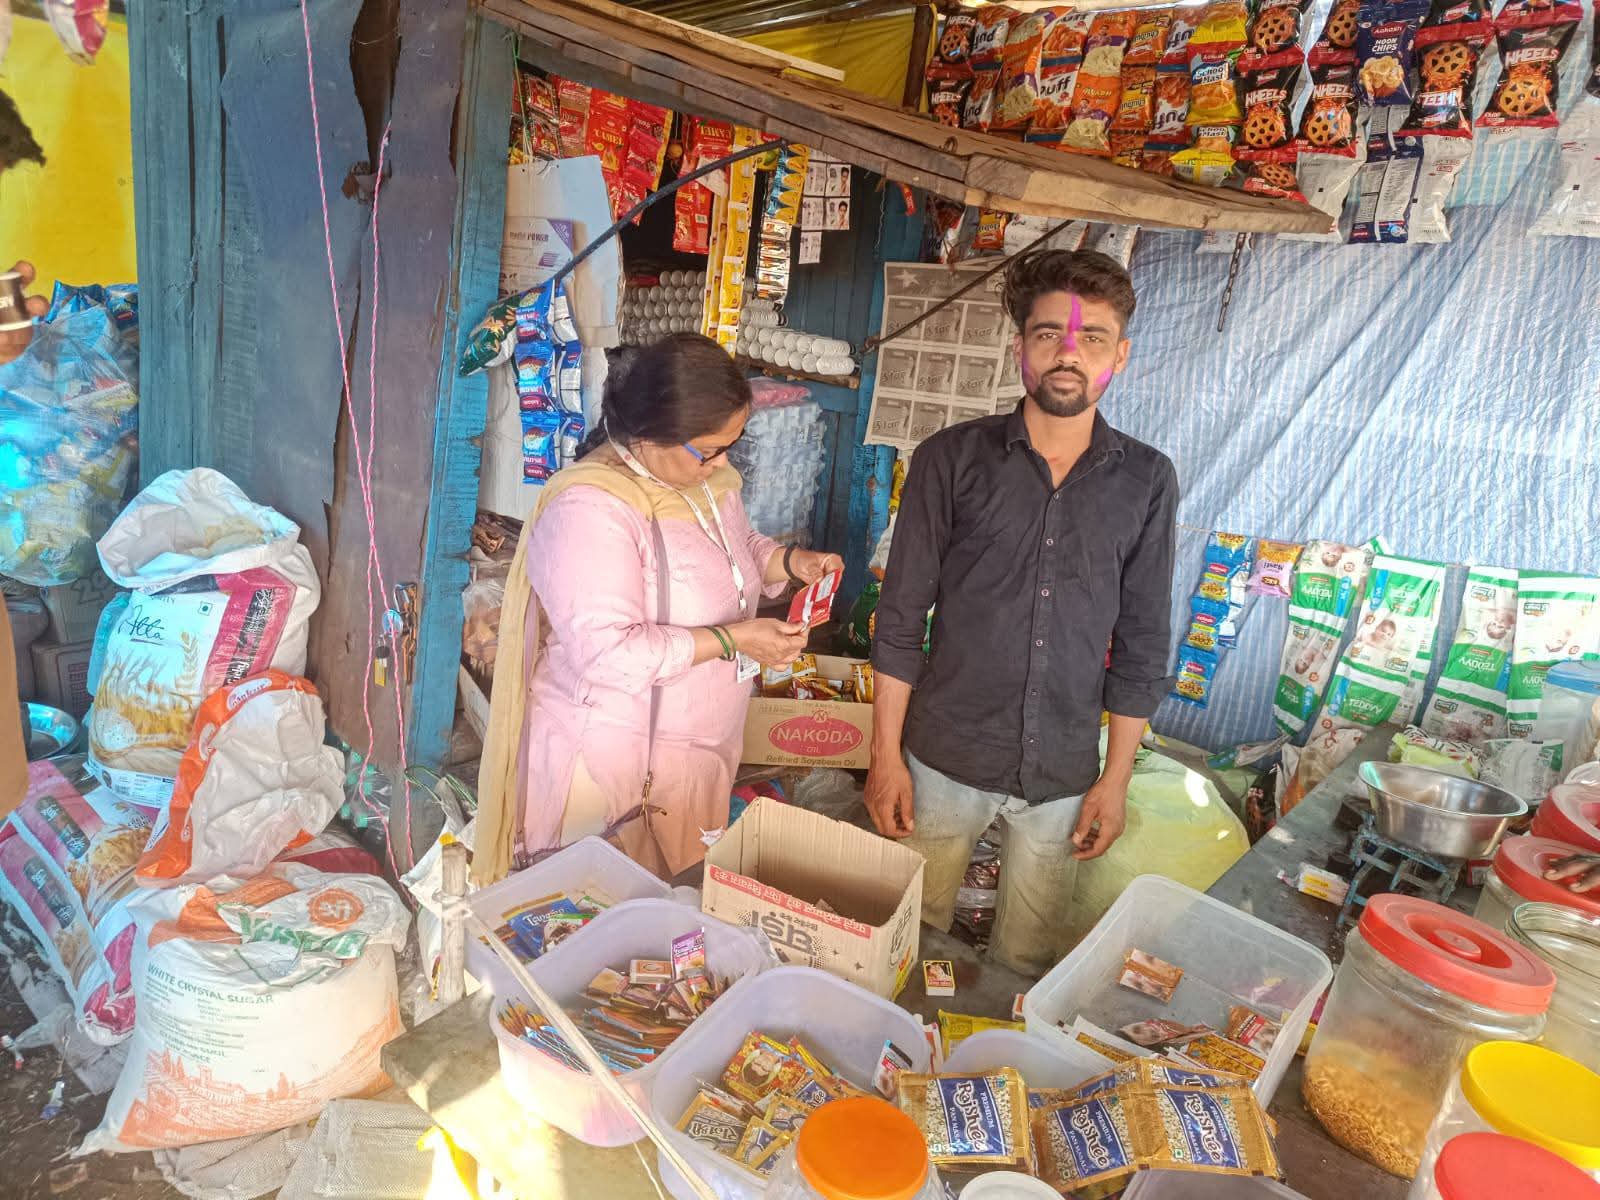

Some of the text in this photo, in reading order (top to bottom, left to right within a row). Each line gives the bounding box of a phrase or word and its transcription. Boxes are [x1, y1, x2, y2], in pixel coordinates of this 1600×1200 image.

[1371, 43, 1398, 53] CHIPS
[1505, 47, 1560, 69] WHEELS
[1245, 87, 1288, 107] WHEELS
[776, 727, 854, 745] NAKODA
[766, 754, 857, 767] Refined Soyabean Oil
[147, 962, 275, 1005] WHITE CRYSTAL SUGAR
[1073, 1144, 1090, 1175] MASALA
